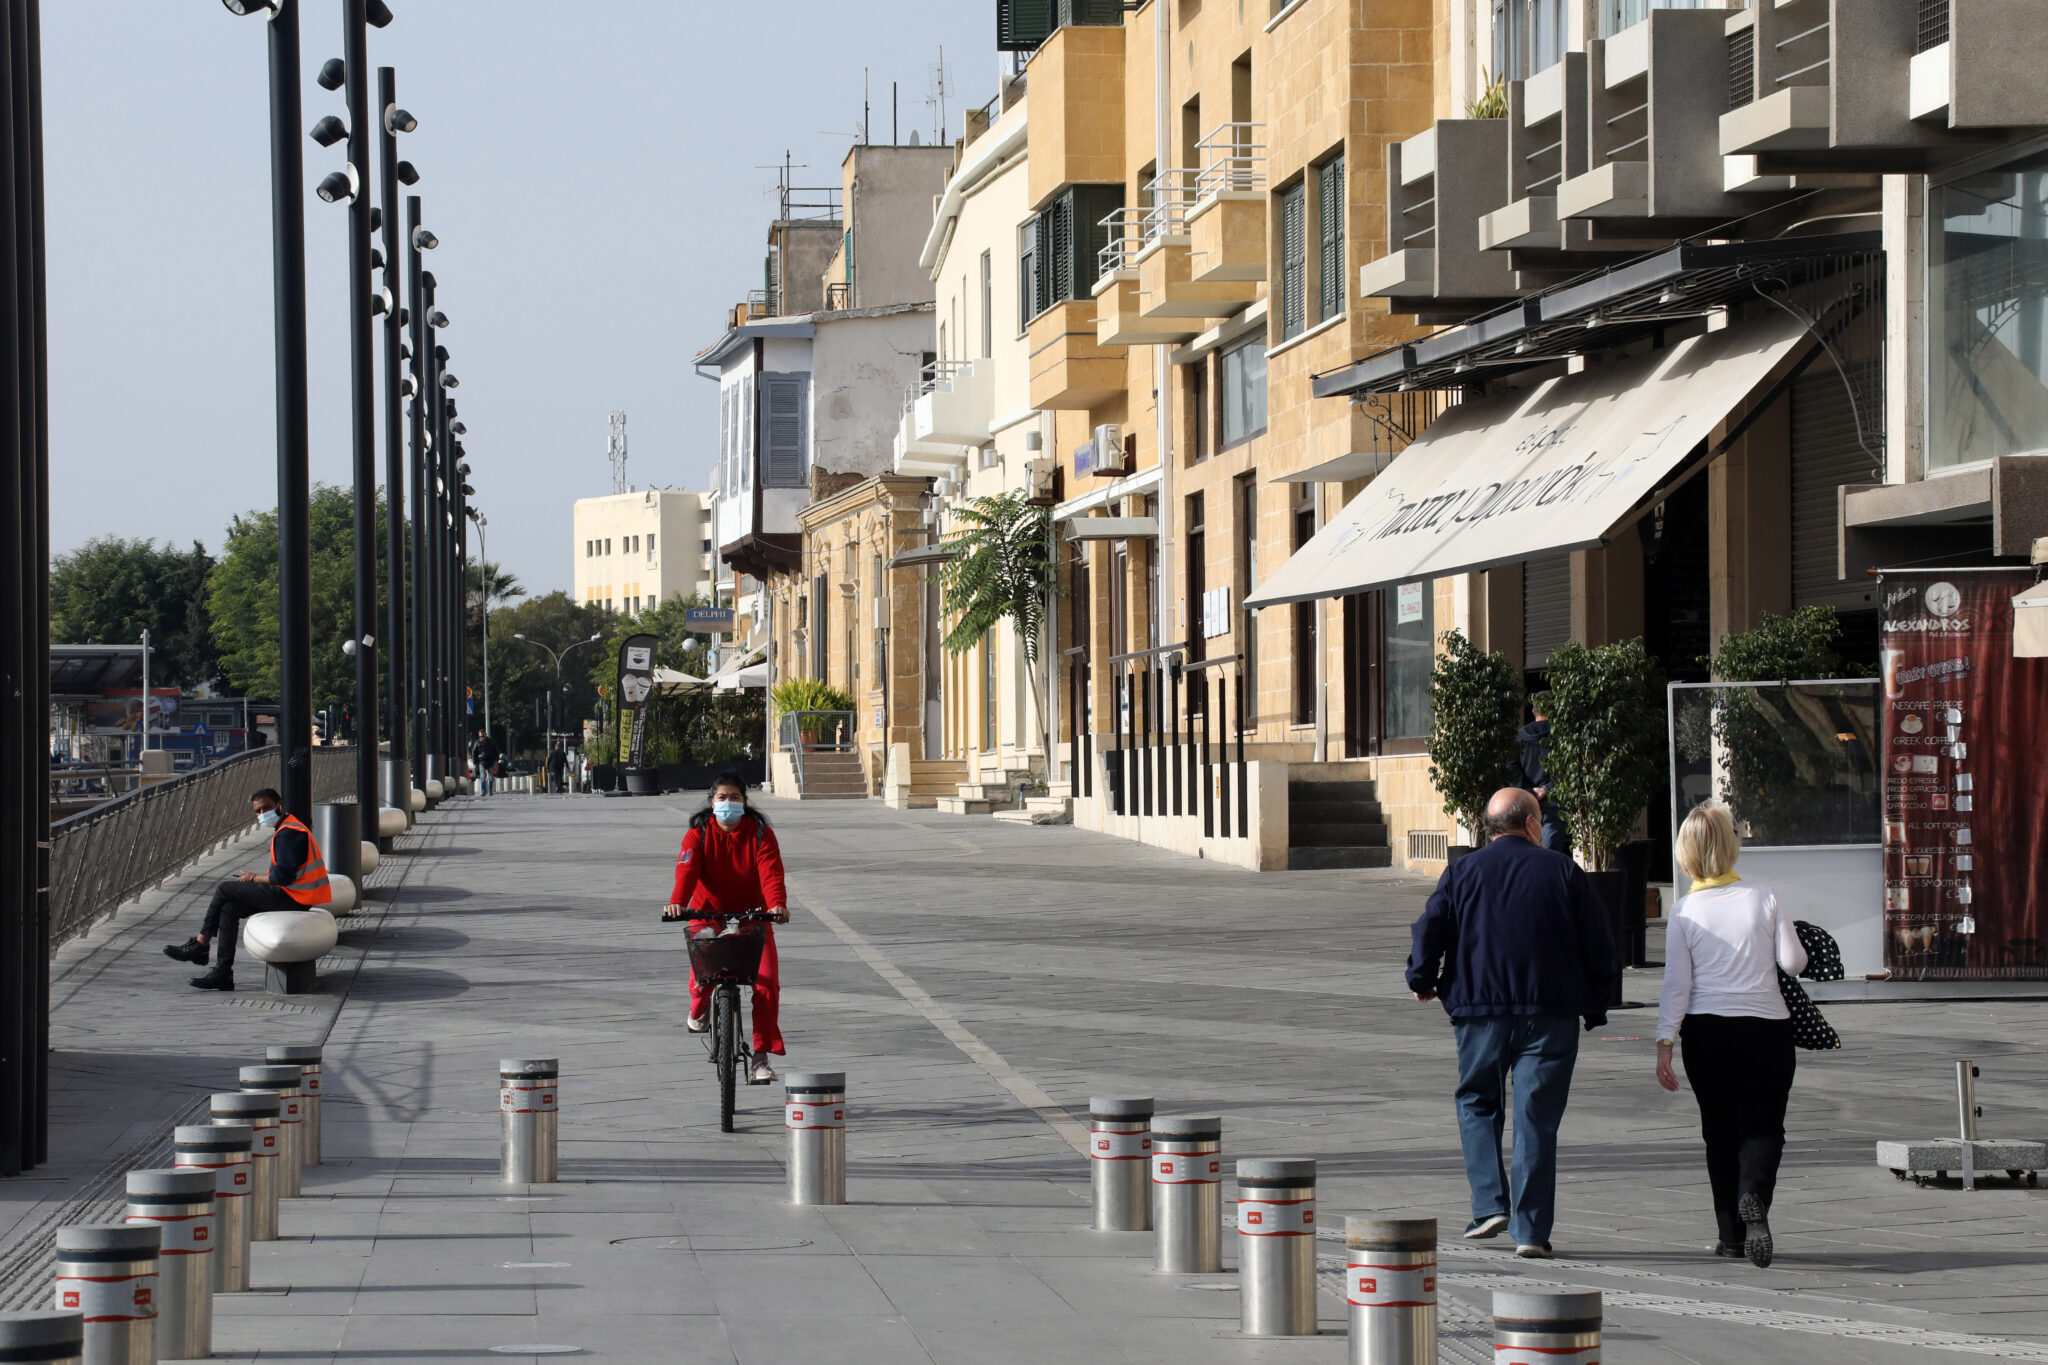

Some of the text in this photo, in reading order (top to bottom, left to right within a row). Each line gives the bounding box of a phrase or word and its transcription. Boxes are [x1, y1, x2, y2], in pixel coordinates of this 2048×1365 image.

[1883, 618, 1970, 632] ALEXANDROS
[621, 710, 632, 740] FREE
[1893, 736, 1921, 745] GREEK
